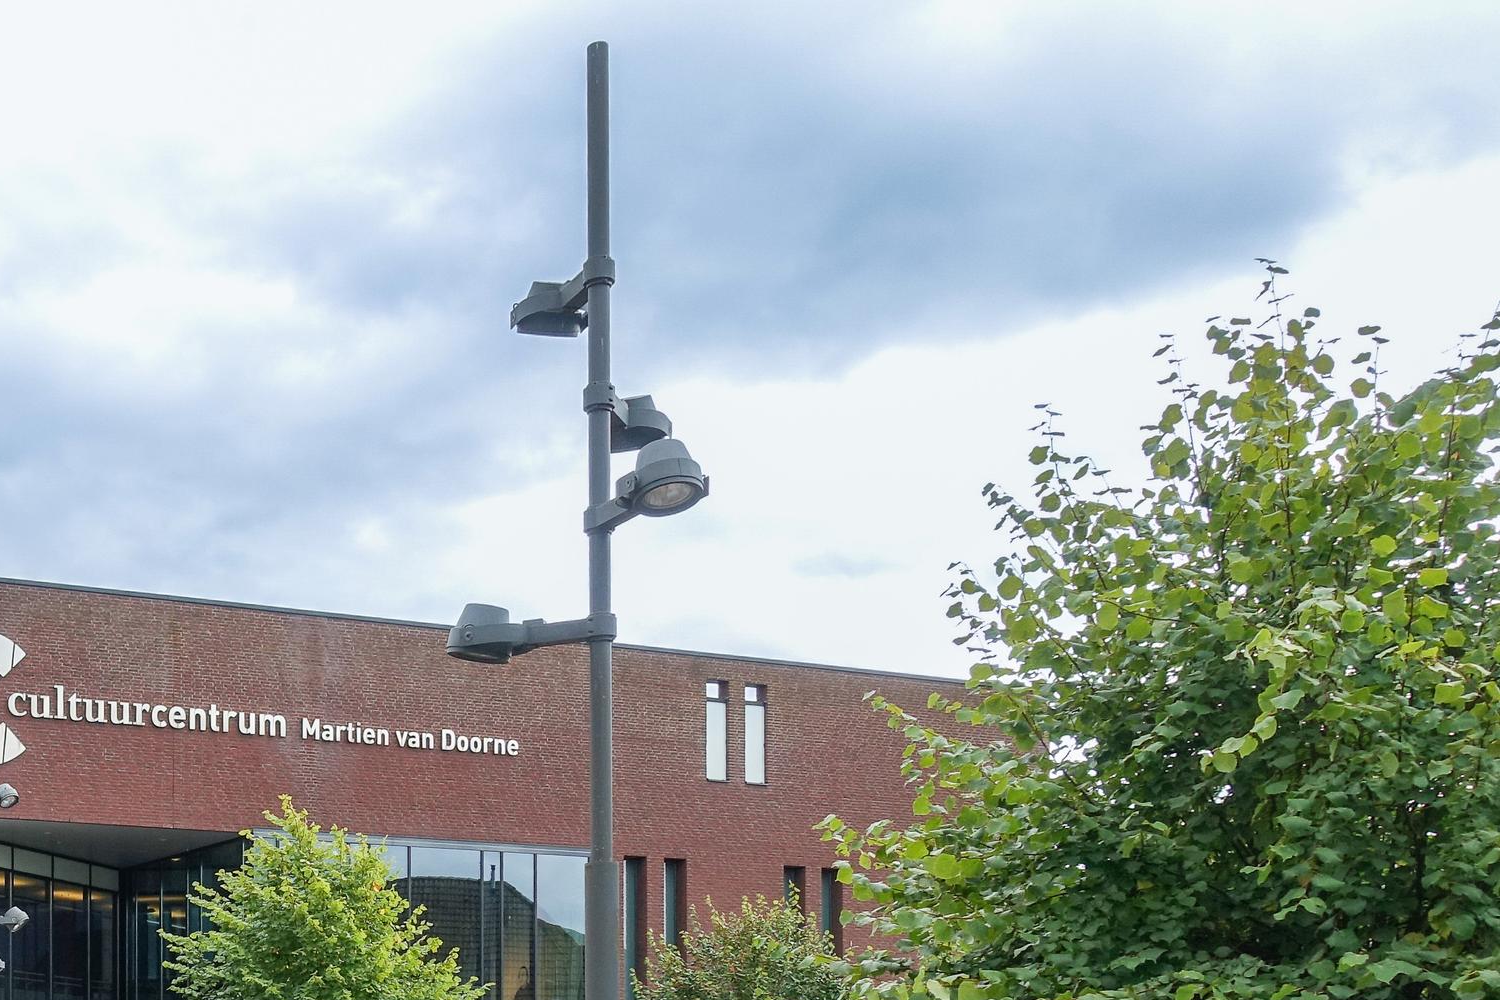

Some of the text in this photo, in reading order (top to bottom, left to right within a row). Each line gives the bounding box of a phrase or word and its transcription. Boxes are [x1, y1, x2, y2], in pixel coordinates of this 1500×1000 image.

[7, 684, 520, 756] cultuurcentrum Martien van Doorne
